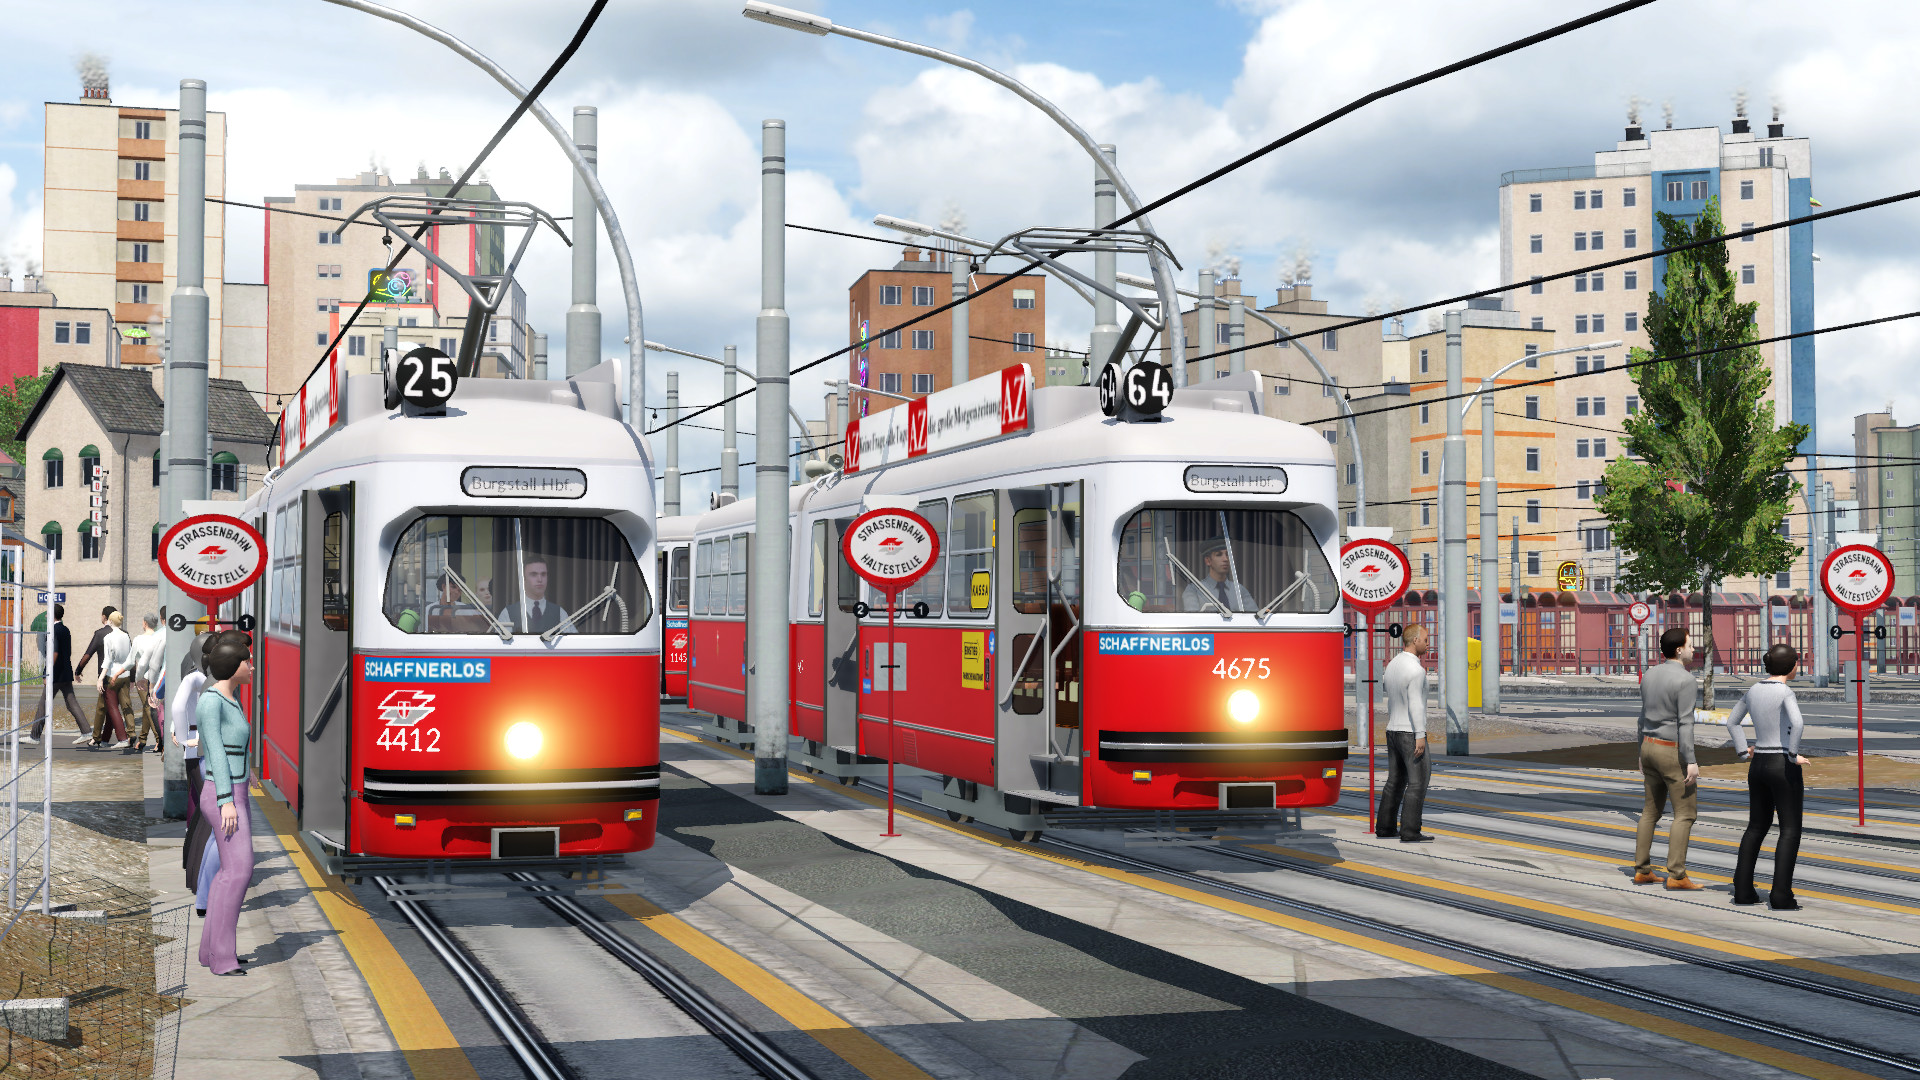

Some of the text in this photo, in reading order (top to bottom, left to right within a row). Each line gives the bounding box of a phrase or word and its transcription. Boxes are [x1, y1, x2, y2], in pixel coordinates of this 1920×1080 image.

[403, 356, 452, 398] 25
[1101, 369, 1116, 408] 64
[1128, 368, 1169, 406] 64
[844, 431, 859, 470] AZ
[908, 409, 927, 453] AZ
[1001, 374, 1026, 425] AZ
[472, 475, 573, 492] Burgstall Hbf.
[1191, 474, 1274, 488] Burgstall Hbf.
[175, 526, 252, 552] STRASSENBAHN
[858, 519, 925, 543] STRASSENBAHN
[860, 553, 923, 575] HALTESTELLE
[1343, 548, 1398, 571] STRASSENBAHN
[1833, 554, 1883, 575] STRASSENBAHN
[178, 563, 248, 585] HALTESTELLE
[39, 593, 62, 602] HOEL
[972, 584, 989, 596] KASSA
[1345, 580, 1397, 599] HALTESTELLE
[1836, 584, 1881, 602] HALTESTELLE
[857, 605, 864, 615] 2
[918, 605, 924, 615] 1
[174, 617, 181, 628] 2
[243, 617, 249, 628] 1
[1393, 626, 1398, 635] 1
[1833, 628, 1839, 637] 2
[1099, 637, 1210, 651] SCHAFFNERLOS
[365, 662, 486, 678] SCHAFFNERLOS
[1212, 657, 1271, 679] 4675
[376, 728, 441, 752] 4412
